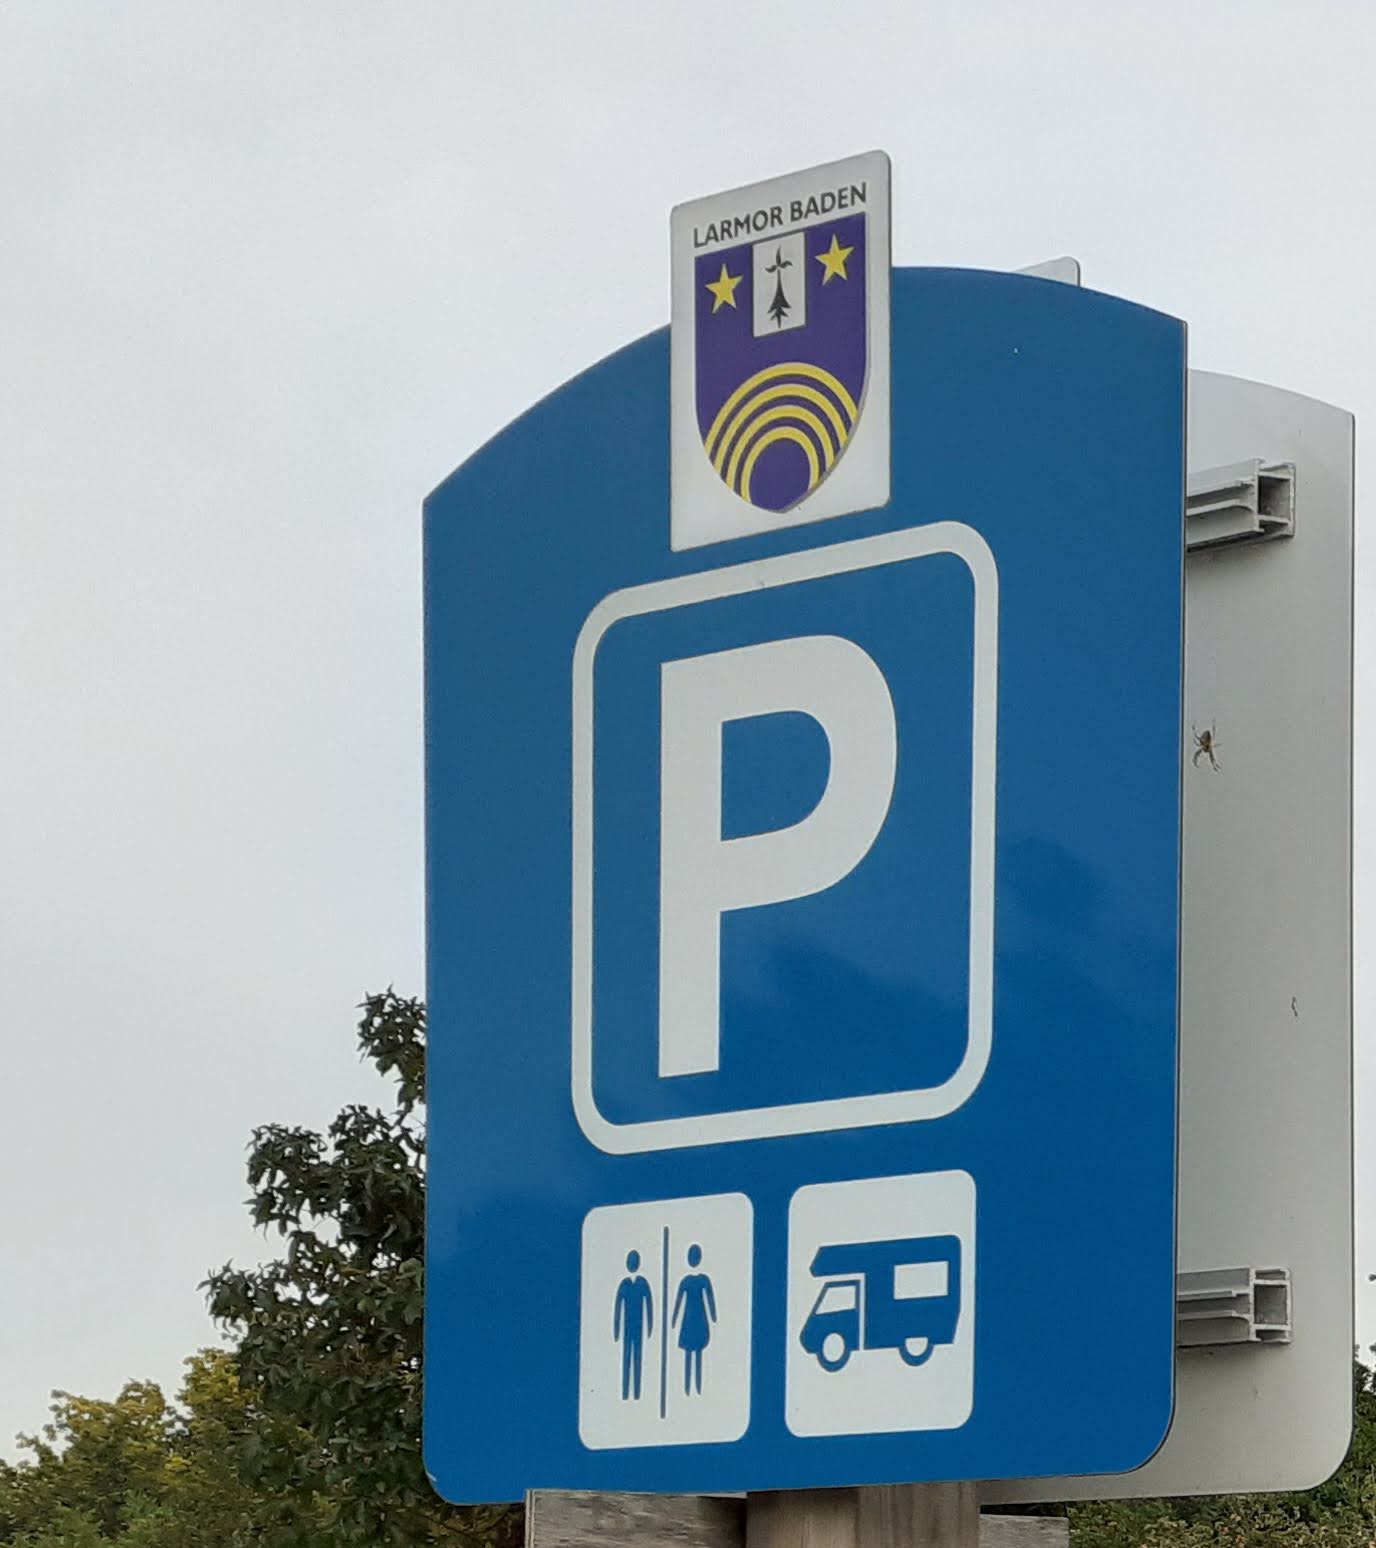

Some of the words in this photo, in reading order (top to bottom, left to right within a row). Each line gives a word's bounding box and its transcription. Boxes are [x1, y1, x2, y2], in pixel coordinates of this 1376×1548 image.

[693, 205, 784, 248] LARMOR
[789, 181, 868, 223] BADEN
[658, 634, 898, 1078] P
